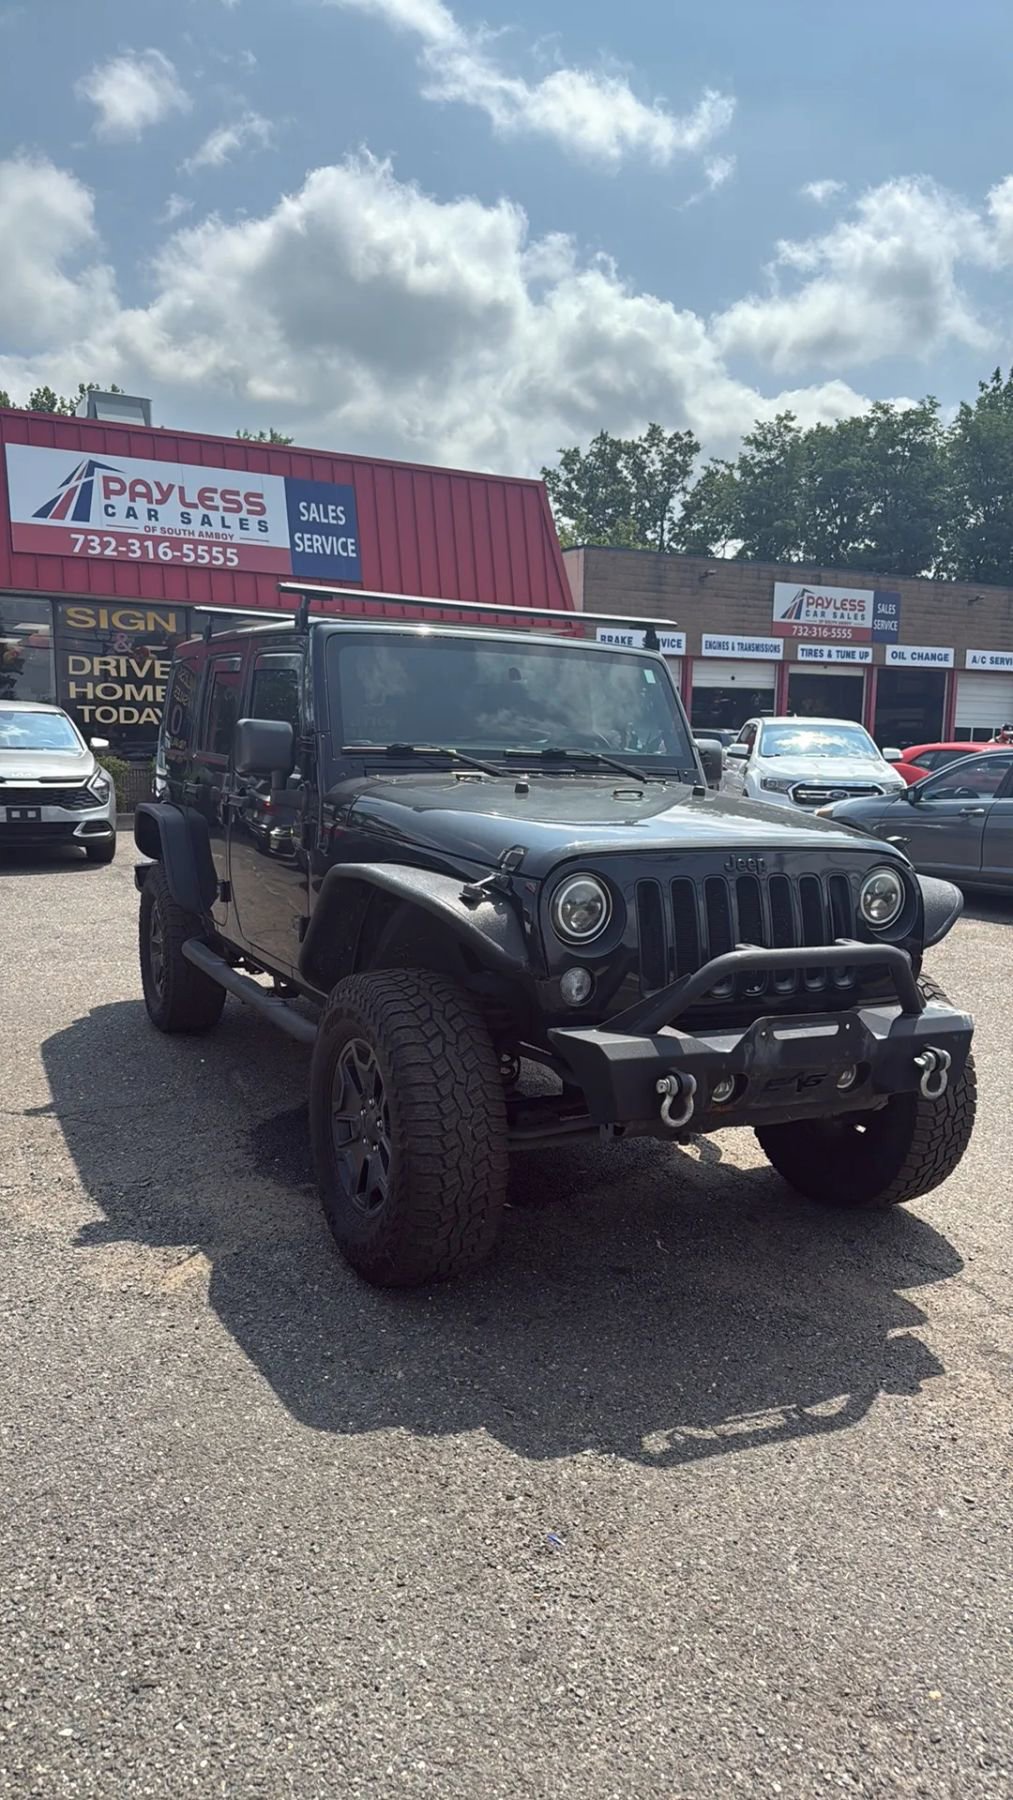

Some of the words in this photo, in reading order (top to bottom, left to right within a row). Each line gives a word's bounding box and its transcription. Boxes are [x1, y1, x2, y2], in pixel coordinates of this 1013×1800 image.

[102, 475, 267, 517] PAYLESS
[104, 504, 159, 522] CAR
[180, 511, 269, 533] SALES
[299, 502, 346, 525] SALES
[144, 525, 157, 533] OF
[160, 526, 195, 537] SOUTH
[198, 531, 235, 541] AMBOY
[70, 534, 240, 567] 732-316-5555
[294, 533, 357, 558] SERVICE
[806, 595, 866, 612] PAYLESS
[877, 603, 896, 615] SALES
[66, 607, 177, 633] SIGN
[805, 609, 826, 618] CAR
[832, 611, 866, 621] SALES
[792, 625, 852, 639] 732-316-5555
[873, 619, 898, 631] SERVICE
[114, 633, 133, 653] &
[642, 636, 682, 649] SVICE
[704, 640, 729, 651] ENGINES
[731, 642, 735, 651] &
[737, 642, 781, 654] TRANSMISSIONS
[800, 648, 824, 658] TIRES
[827, 649, 832, 658] &
[836, 649, 856, 659] TUNE
[858, 651, 870, 660] UP
[891, 650, 906, 660] OIL
[911, 652, 950, 662] CHANGE
[971, 655, 986, 665] A/C
[68, 655, 172, 679] DRIVE
[69, 681, 167, 702] HOME
[724, 853, 767, 875] Jeep
